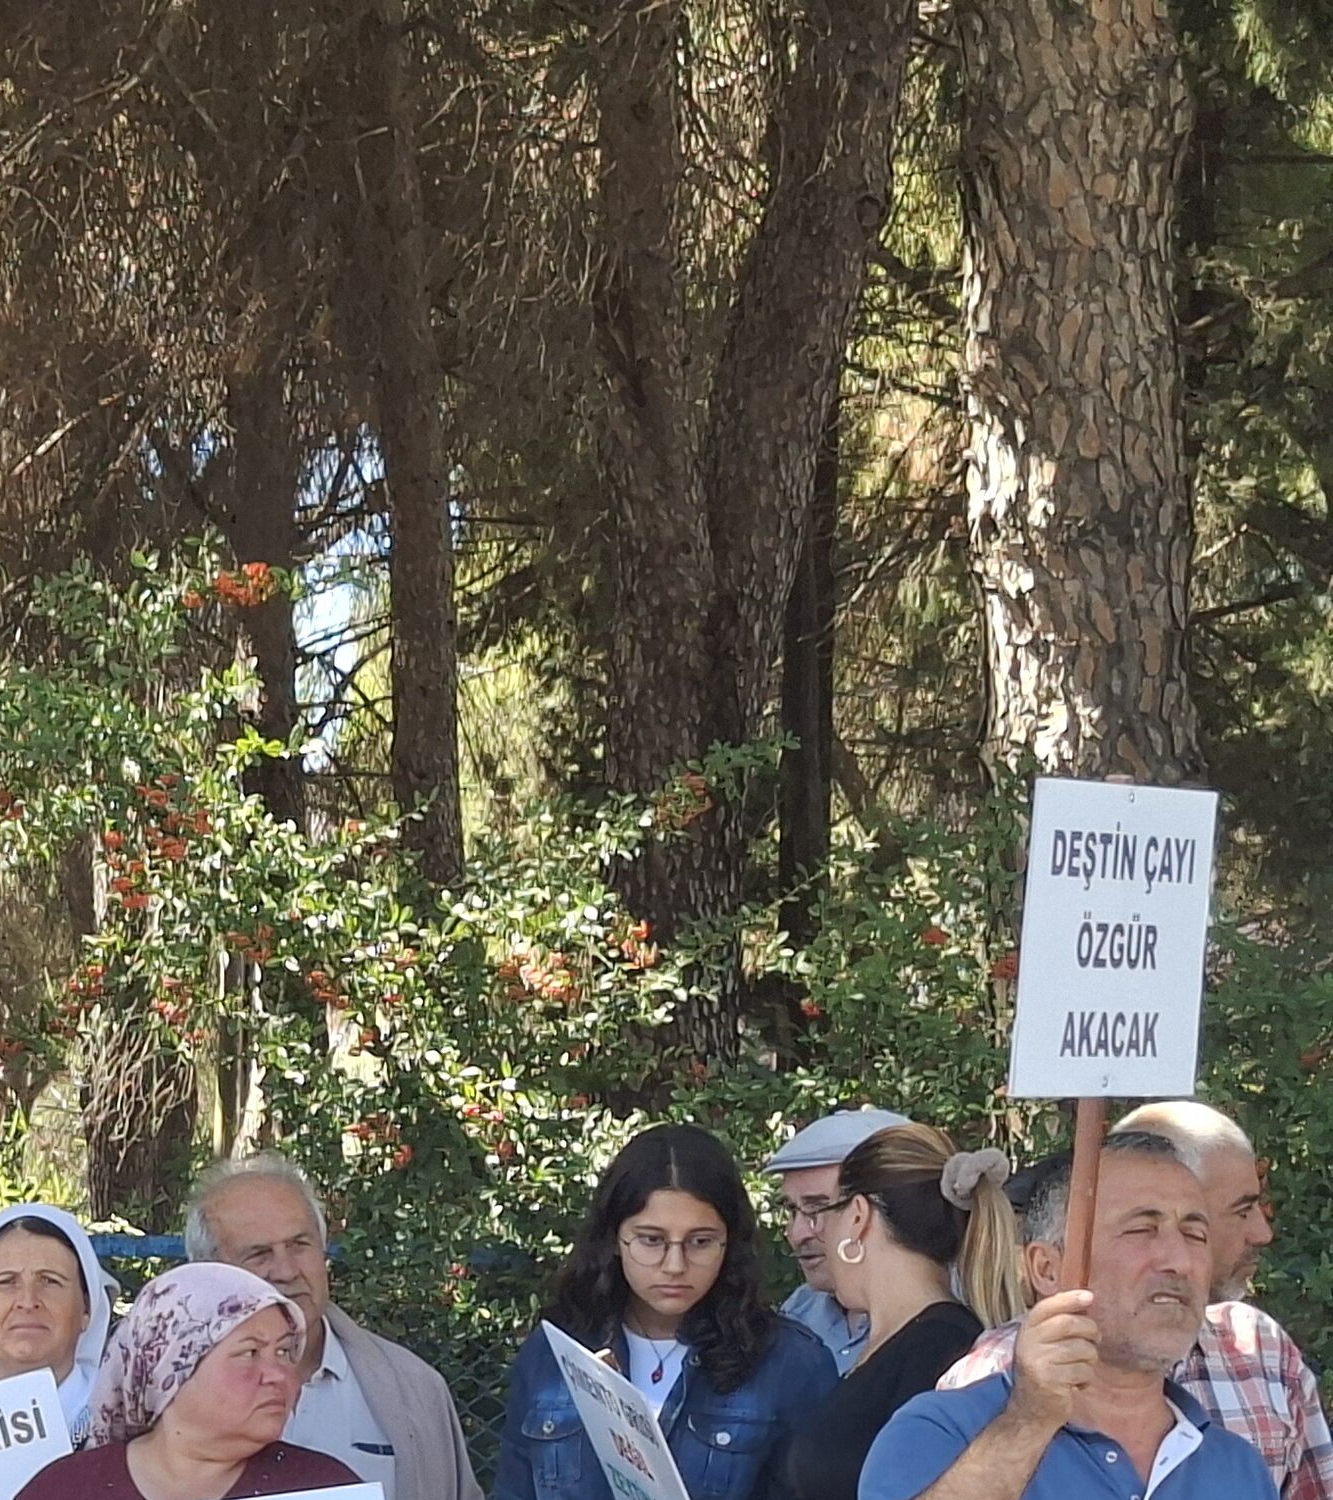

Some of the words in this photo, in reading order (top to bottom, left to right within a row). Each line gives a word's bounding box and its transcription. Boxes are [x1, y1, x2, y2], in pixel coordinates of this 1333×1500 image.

[1051, 822, 1137, 890] DEŞTİN
[1144, 836, 1195, 894] ÇAYI
[1076, 911, 1157, 970] ÖZGÜR
[1060, 1011, 1159, 1057] AKACAK
